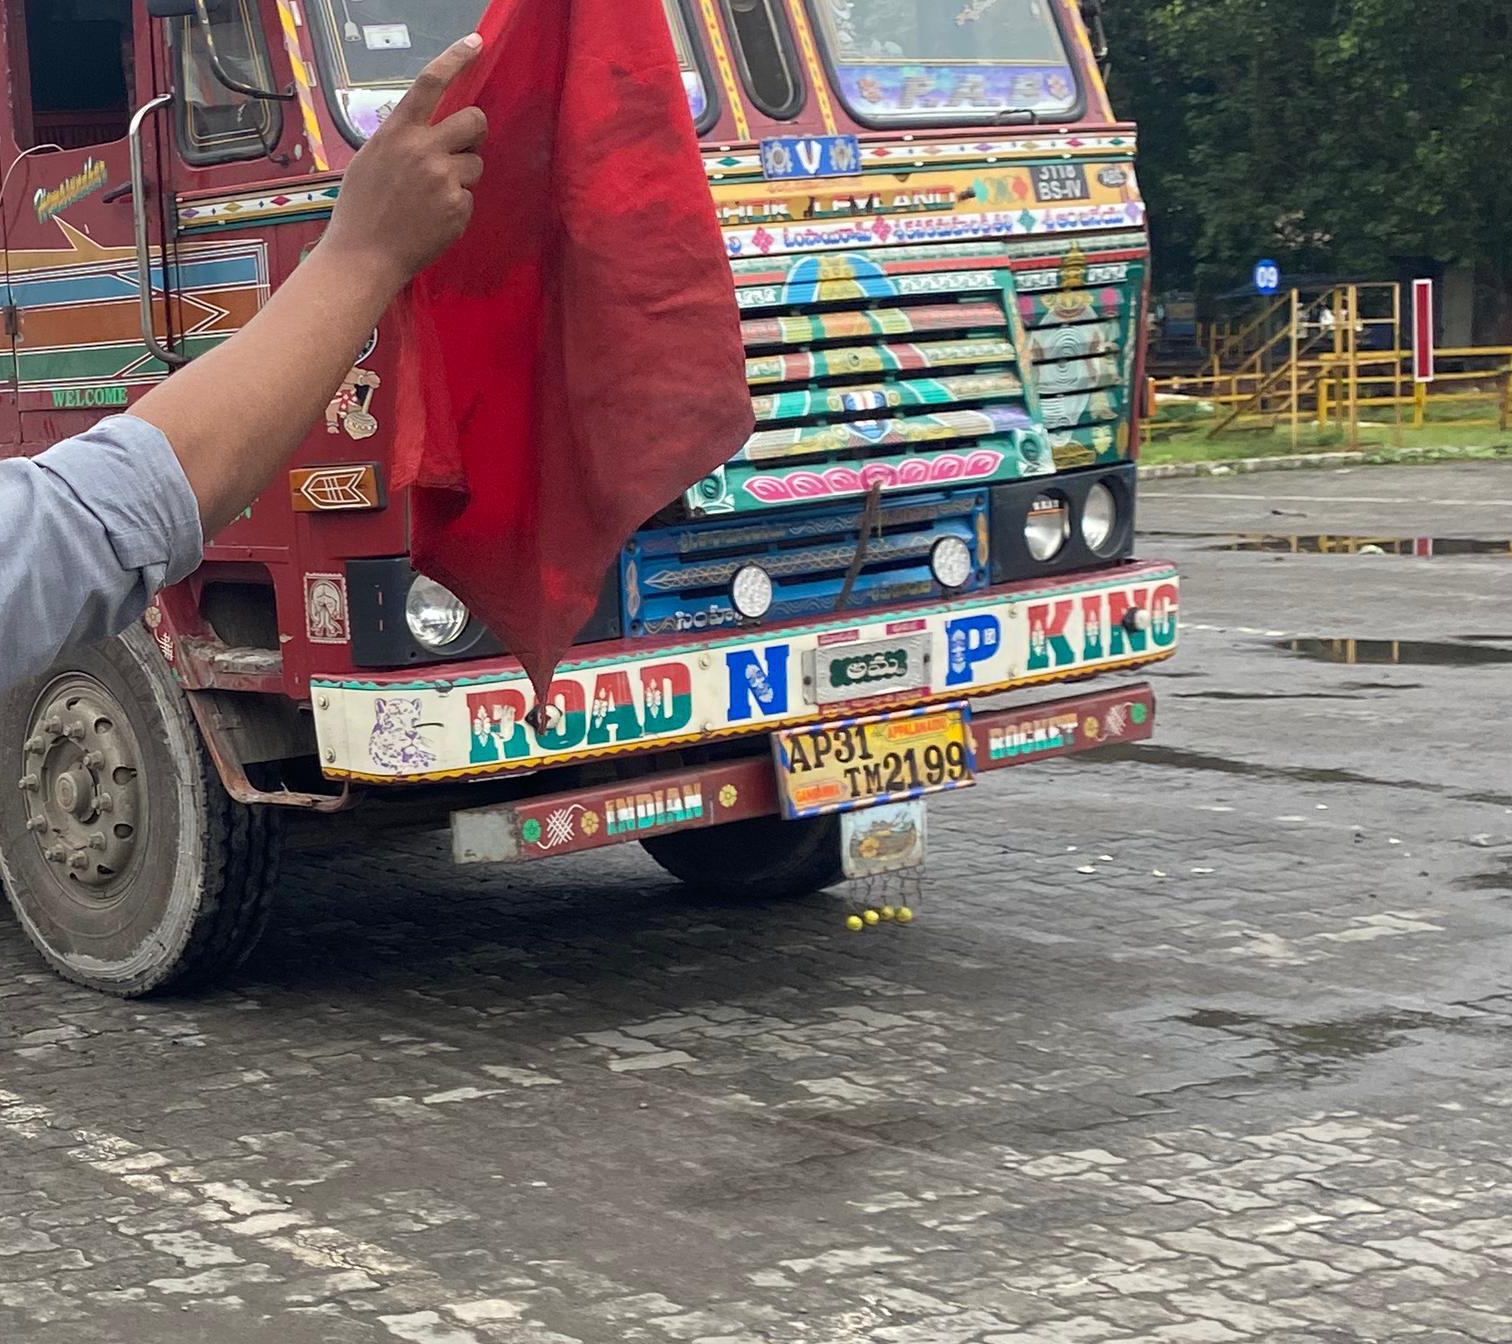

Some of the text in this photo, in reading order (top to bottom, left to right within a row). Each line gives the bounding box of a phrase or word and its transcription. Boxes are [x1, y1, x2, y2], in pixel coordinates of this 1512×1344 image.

[52, 387, 128, 408] WELCOME
[466, 583, 1179, 763] ROAD N P KING
[789, 725, 874, 774] AP31
[989, 713, 1078, 760] ROCKET
[605, 782, 704, 836] INDIAN
